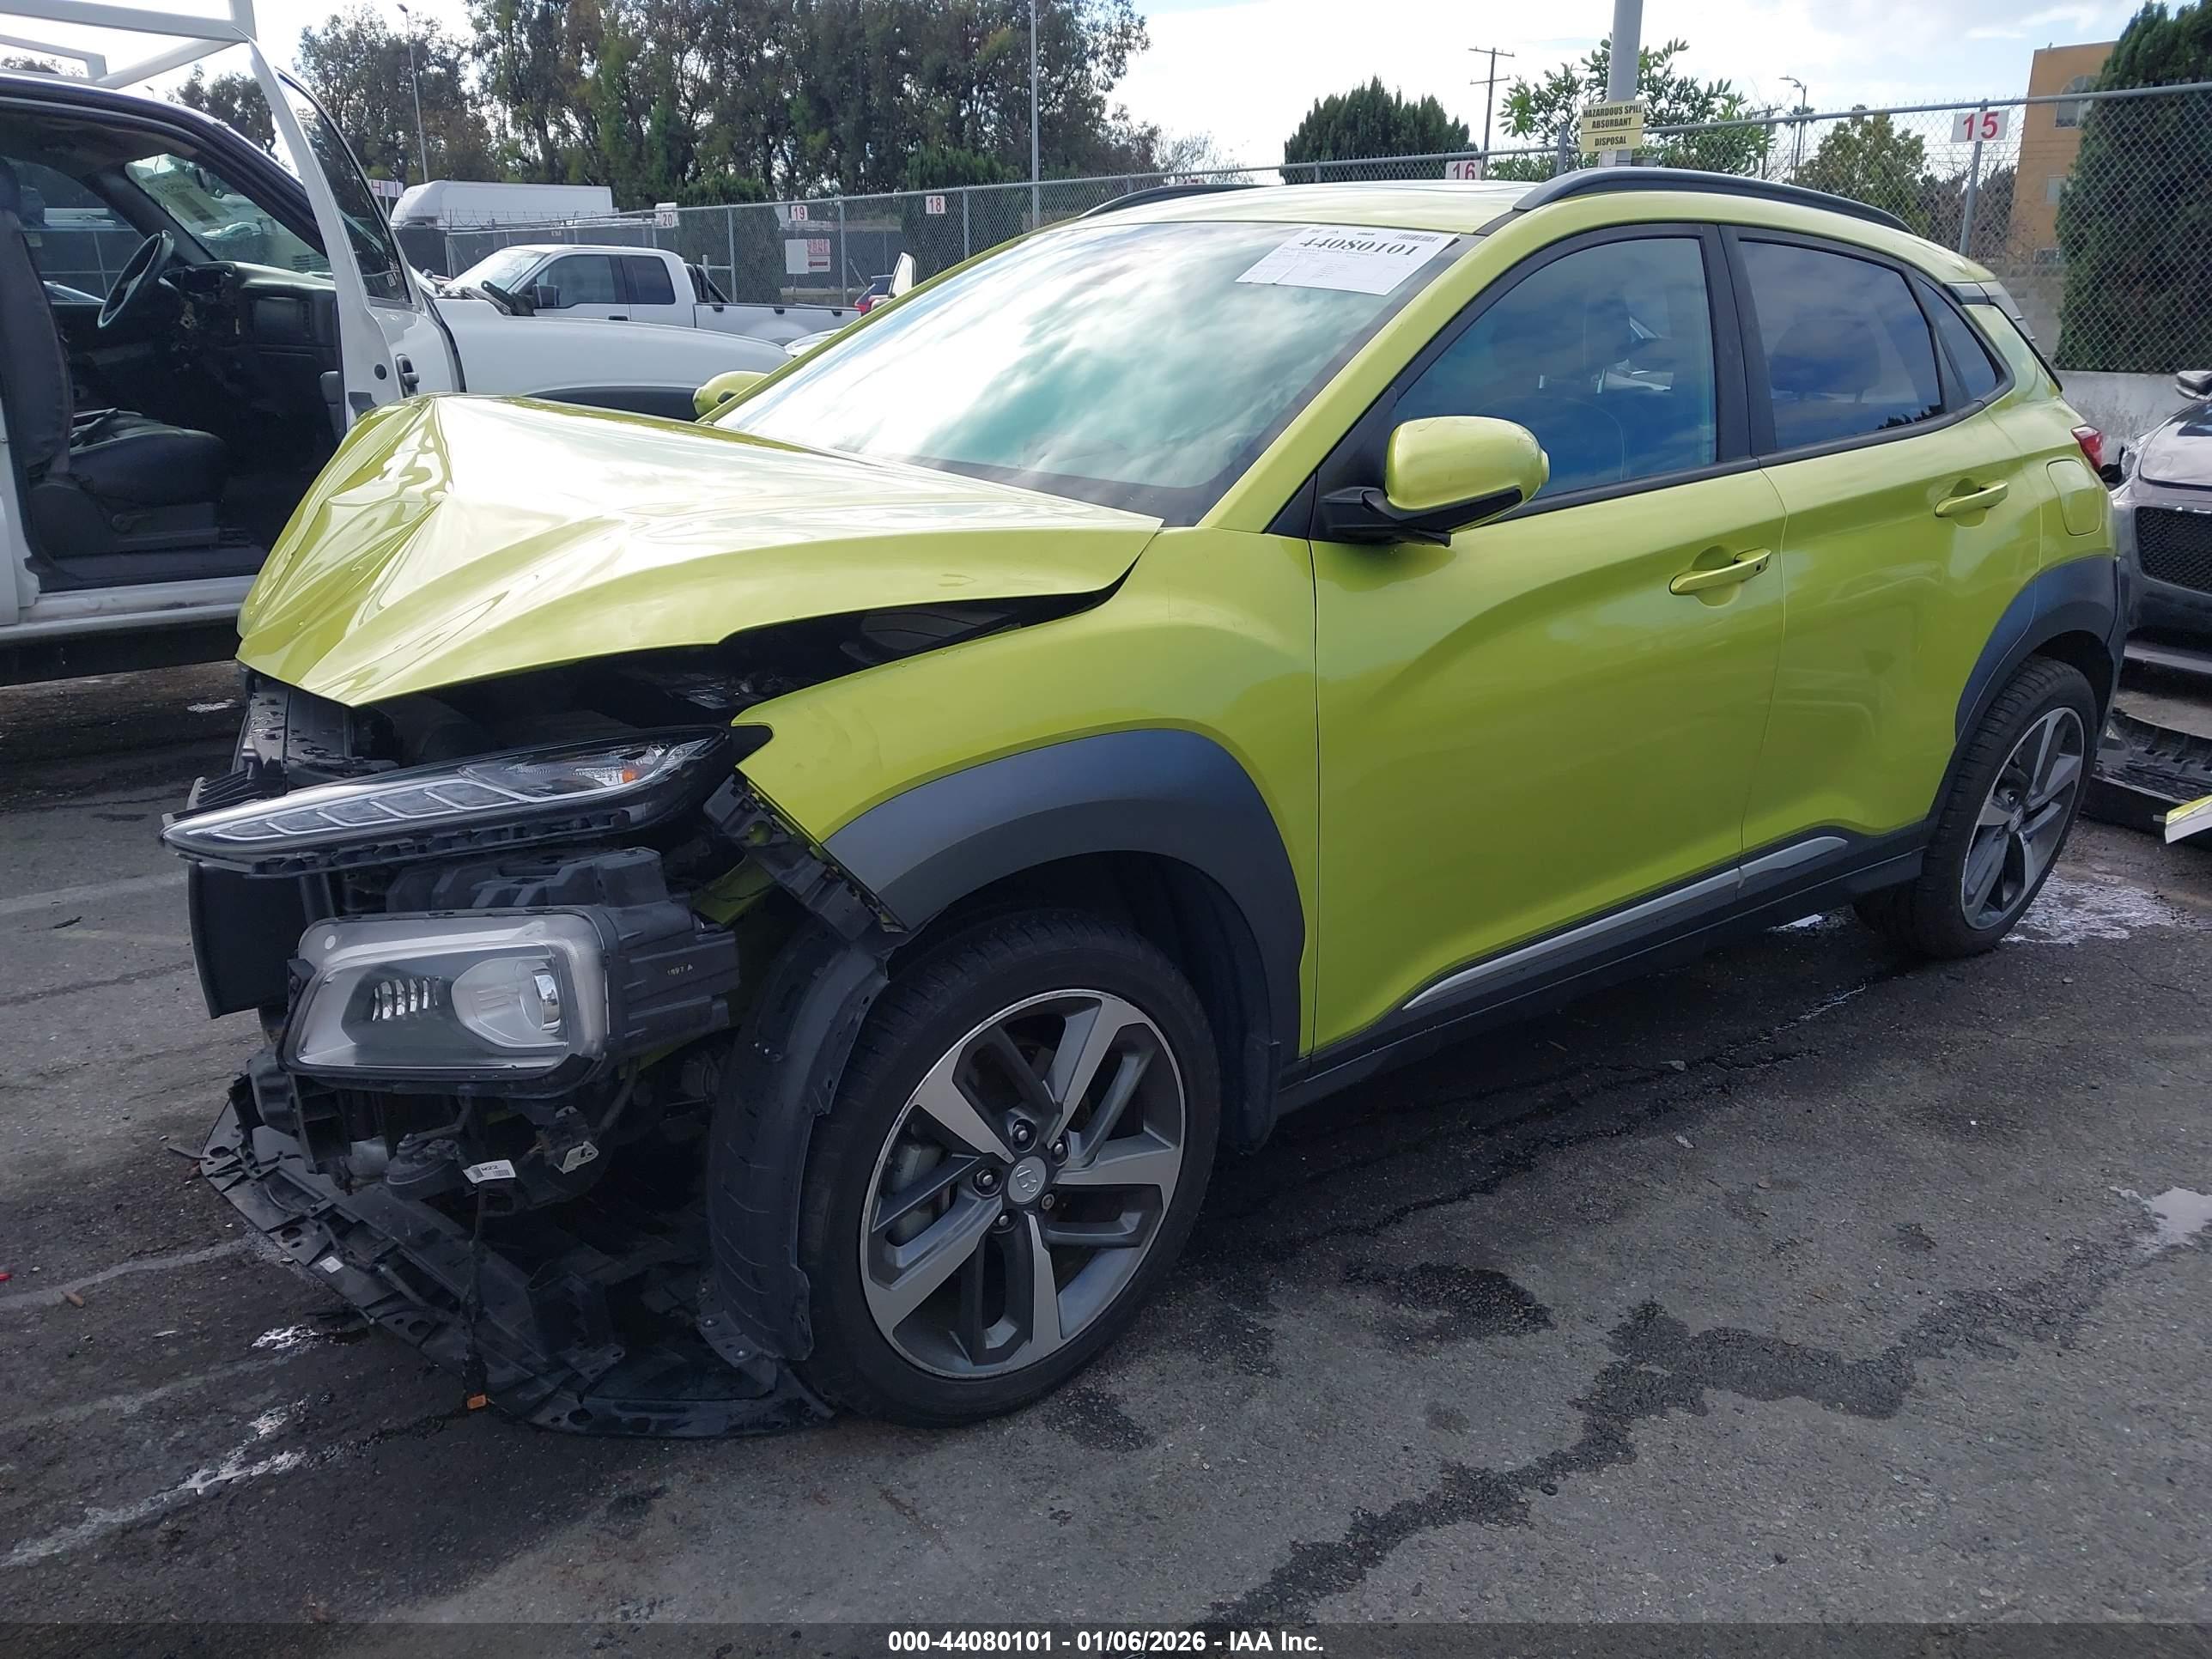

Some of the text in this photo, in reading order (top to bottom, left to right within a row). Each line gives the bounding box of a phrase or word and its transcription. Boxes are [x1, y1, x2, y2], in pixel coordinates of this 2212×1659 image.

[1583, 104, 1642, 118] HAZARDOUS SPILL
[1592, 117, 1632, 129] ABSORBANT
[1963, 111, 1999, 141] 15
[1595, 136, 1627, 146] DISPOSAL
[1452, 161, 1476, 179] 16
[929, 197, 942, 213] 18
[662, 213, 673, 227] 20
[794, 206, 805, 221] 19
[1298, 236, 1420, 256] 44080101
